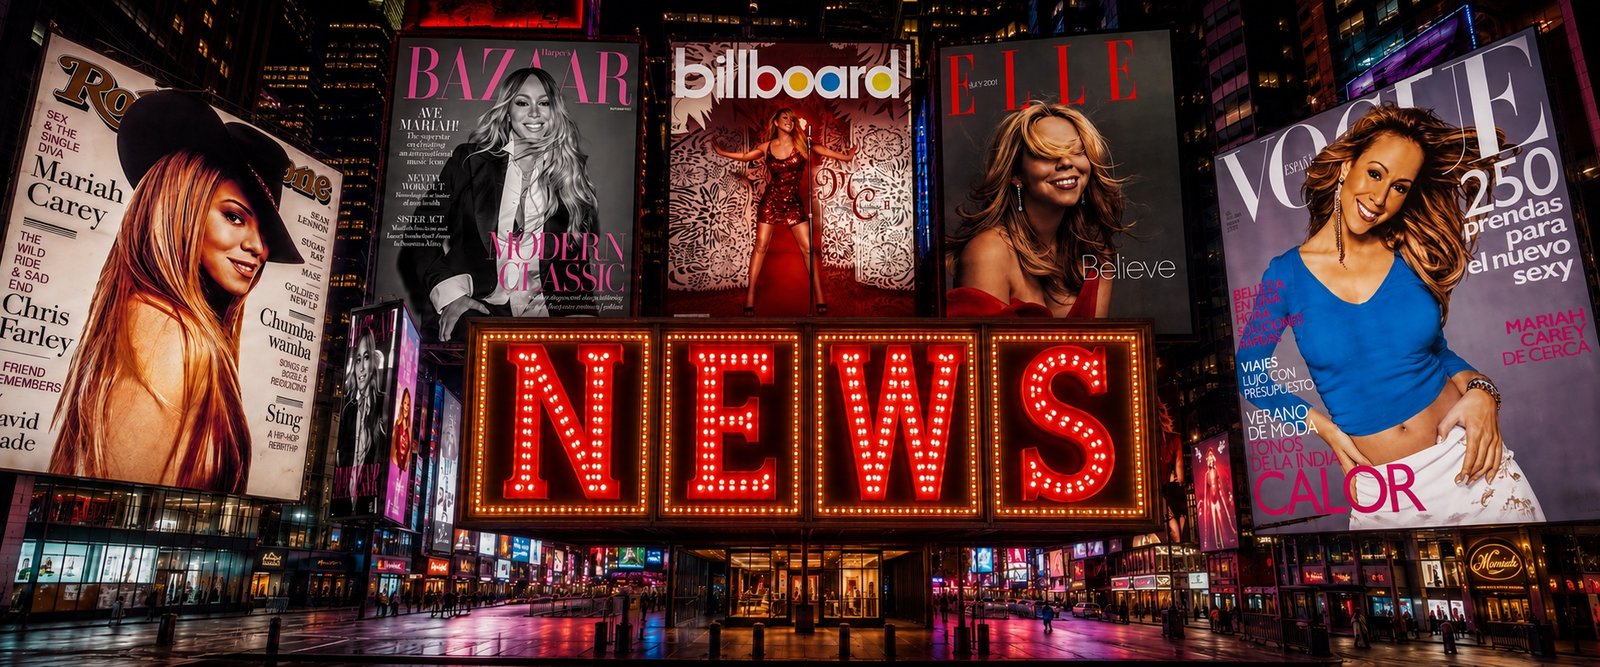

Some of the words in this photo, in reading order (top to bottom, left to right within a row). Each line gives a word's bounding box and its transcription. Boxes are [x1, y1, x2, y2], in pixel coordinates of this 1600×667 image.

[541, 48, 571, 58] Harper's
[675, 47, 900, 99] billboard
[946, 39, 1137, 116] ELLE
[983, 79, 998, 87] 2001
[47, 109, 68, 125] SEX
[418, 107, 443, 119] AVE
[43, 121, 53, 131] &
[56, 124, 77, 140] THE
[400, 119, 460, 132] MARIAH!
[38, 142, 64, 159] DIVA
[41, 131, 80, 153] SINGLE
[31, 154, 123, 204] Mariah
[1460, 146, 1559, 219] 250
[27, 182, 108, 230] Carey
[297, 214, 329, 235] LENNON
[310, 211, 330, 226] SEAN
[396, 215, 426, 224] SISTER
[1463, 196, 1564, 244] prendas
[20, 231, 42, 245] THE
[1506, 217, 1568, 251] para
[17, 242, 46, 258] WILD
[301, 237, 326, 254] SUGAR
[486, 231, 627, 261] MODERN
[13, 254, 41, 270] RIDE
[310, 251, 325, 263] RAY
[1082, 253, 1176, 281] Believe
[1467, 251, 1488, 275] el
[1492, 239, 1571, 270] nuevo
[11, 267, 20, 278] &
[24, 270, 49, 284] SAD
[301, 268, 322, 282] MASE
[499, 261, 625, 293] CLASSIC
[1513, 258, 1574, 285] sexy
[8, 279, 33, 293] END
[284, 281, 320, 302] GOLDIE'S
[1233, 278, 1285, 301] BELLEZA
[3, 293, 70, 326] Chris
[289, 294, 308, 308] NEW
[308, 300, 318, 311] LP
[1234, 301, 1251, 313] EN
[1236, 307, 1271, 325] HORA
[1505, 307, 1586, 335] MARIAH
[0, 316, 74, 357] Farley
[1520, 322, 1587, 347] CAREY
[268, 335, 311, 361] wamba
[1502, 349, 1528, 366] DE
[1529, 339, 1593, 362] CERCA
[3, 361, 46, 378] FRIEND
[1241, 356, 1278, 373] VIAJES
[1242, 372, 1268, 387] LUJO
[1270, 366, 1296, 381] CON
[1244, 378, 1315, 400] PRESUPUESTO
[265, 403, 303, 434] Sting
[503, 343, 1115, 501] NEWS
[1246, 404, 1309, 425] VERANO
[1248, 424, 1268, 441] DE
[1270, 419, 1319, 439] MODA
[1249, 436, 1304, 456] TONOS
[1250, 456, 1272, 473] DE
[1273, 454, 1294, 470] LA
[1296, 450, 1342, 469] INDIA
[1253, 463, 1427, 517] CALOR
